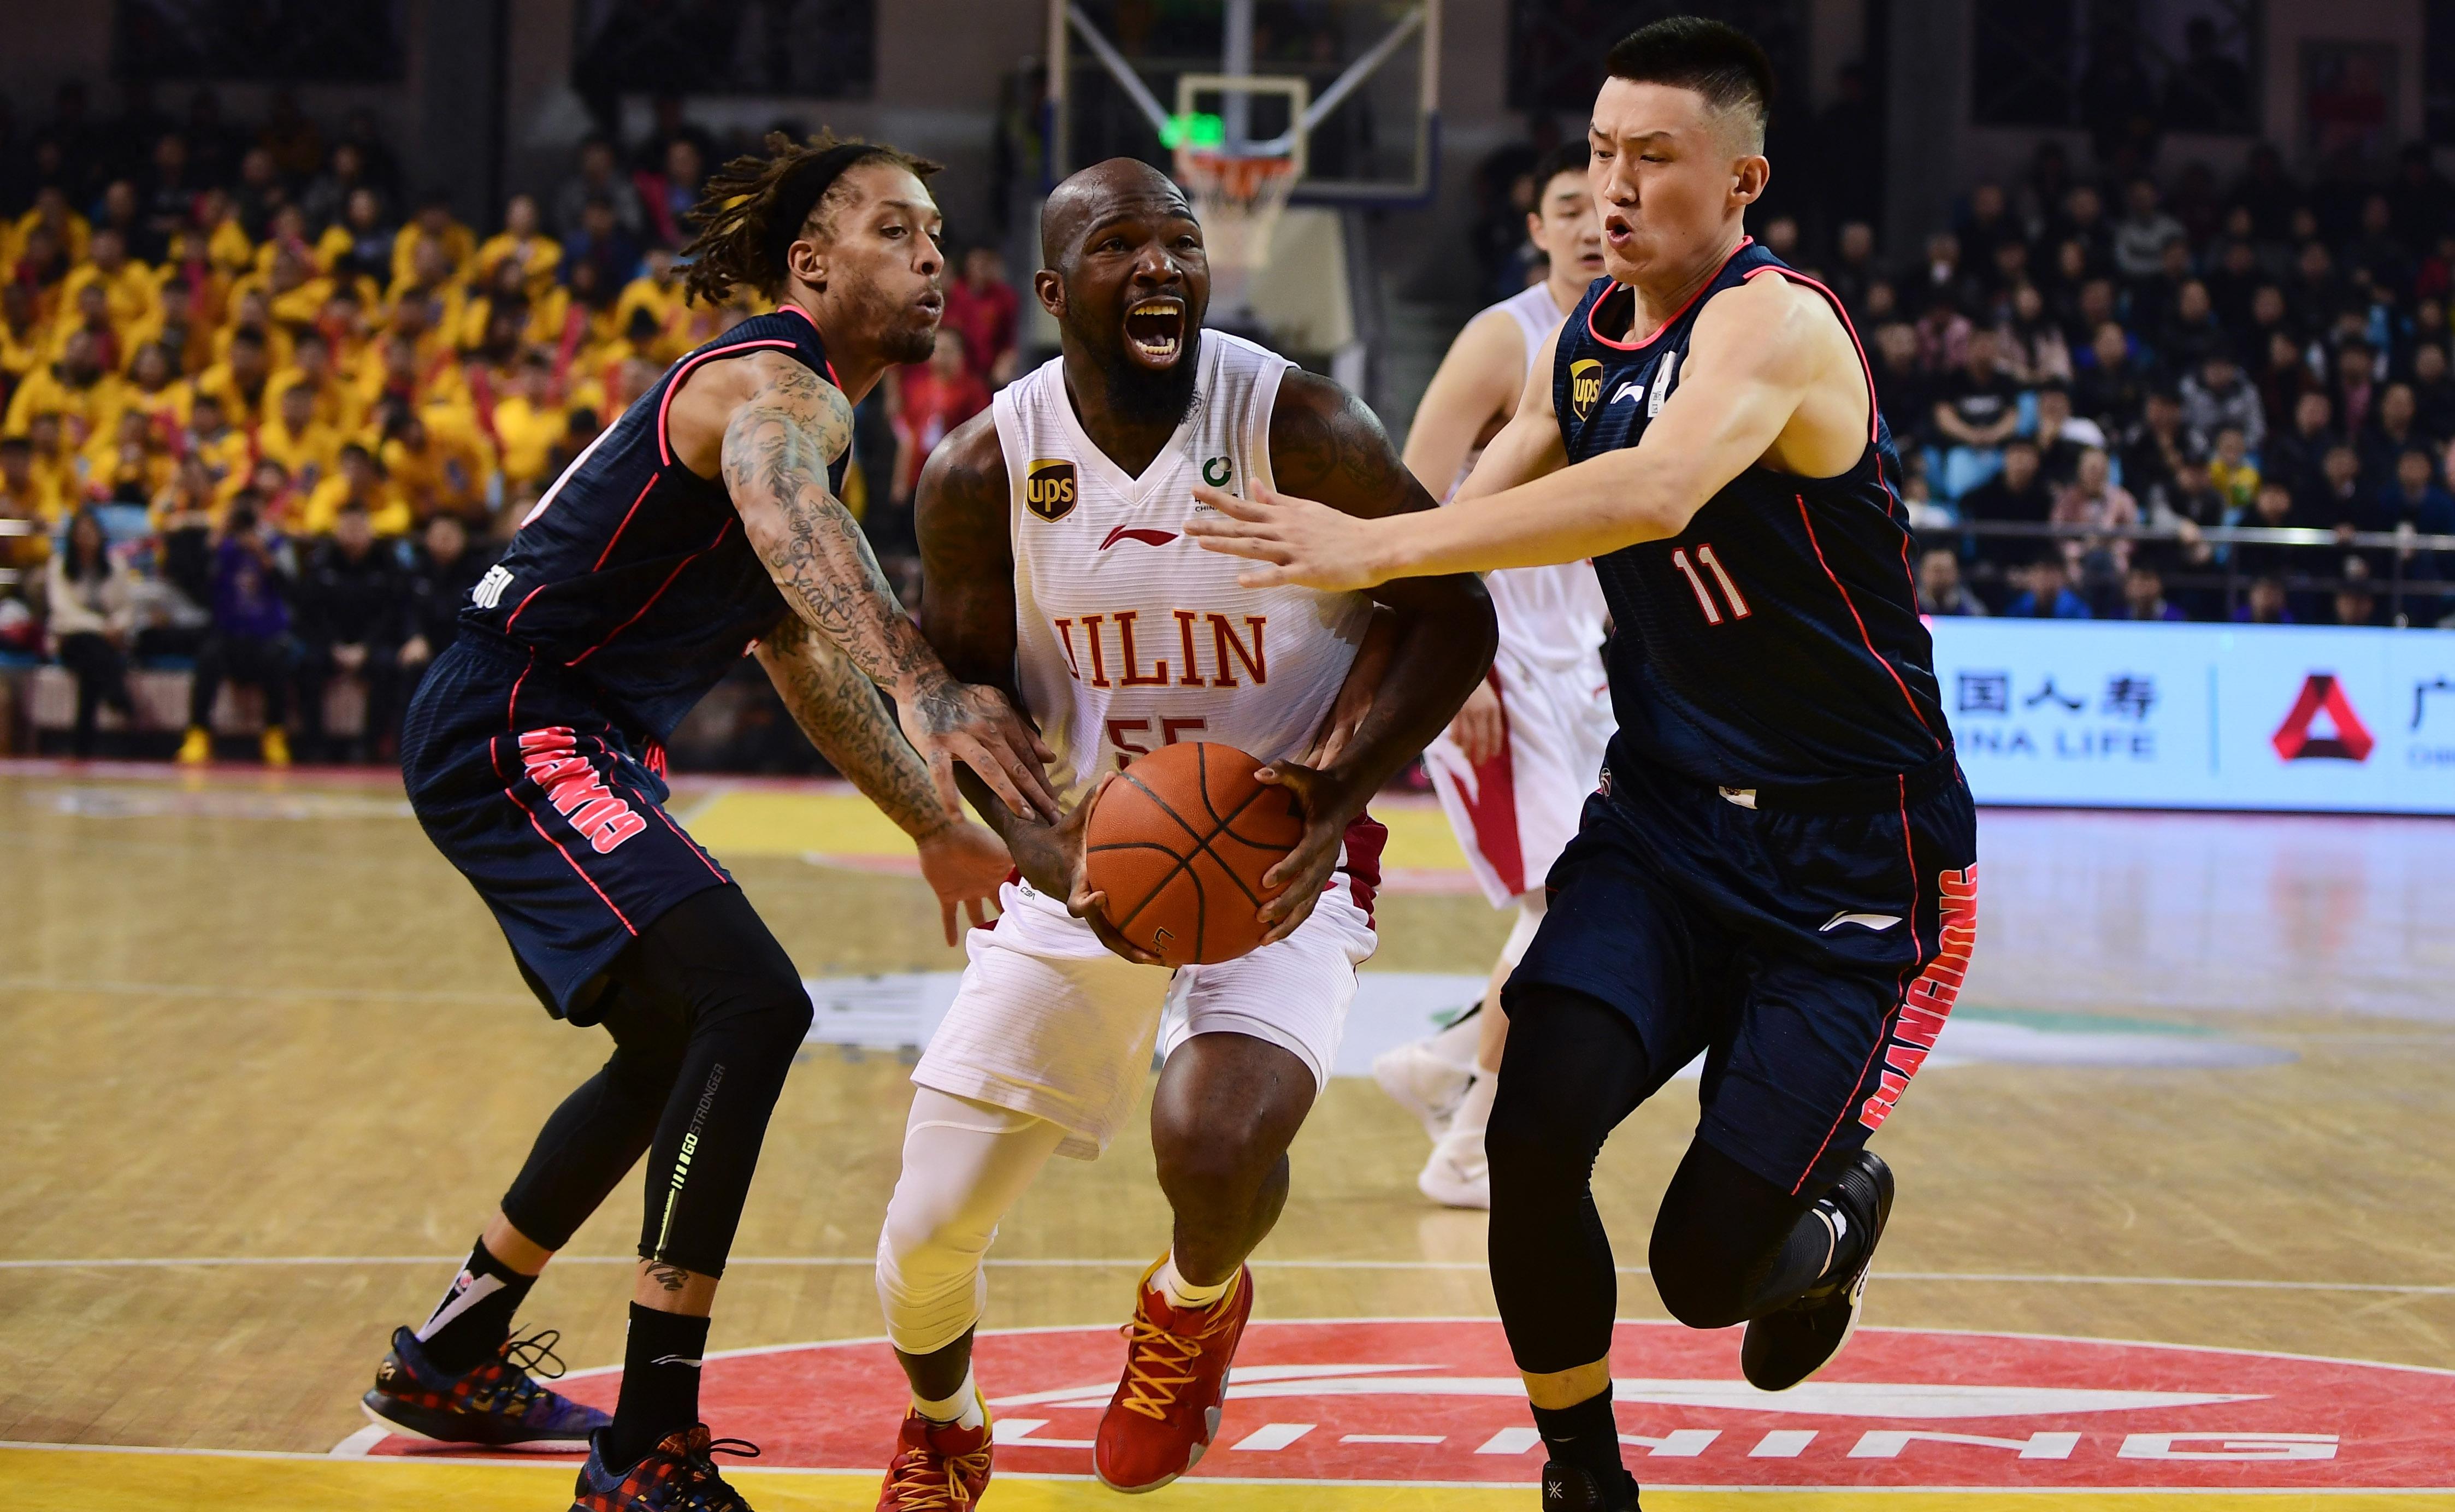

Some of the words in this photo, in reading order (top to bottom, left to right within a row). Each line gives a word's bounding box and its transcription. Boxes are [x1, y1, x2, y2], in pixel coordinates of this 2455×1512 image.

[1575, 379, 1600, 412] ups
[1028, 478, 1074, 512] ups
[1671, 543, 1751, 625] 11
[1954, 674, 2155, 720] 国人寿
[1955, 729, 2039, 759] INA
[2054, 729, 2158, 760] LIFE
